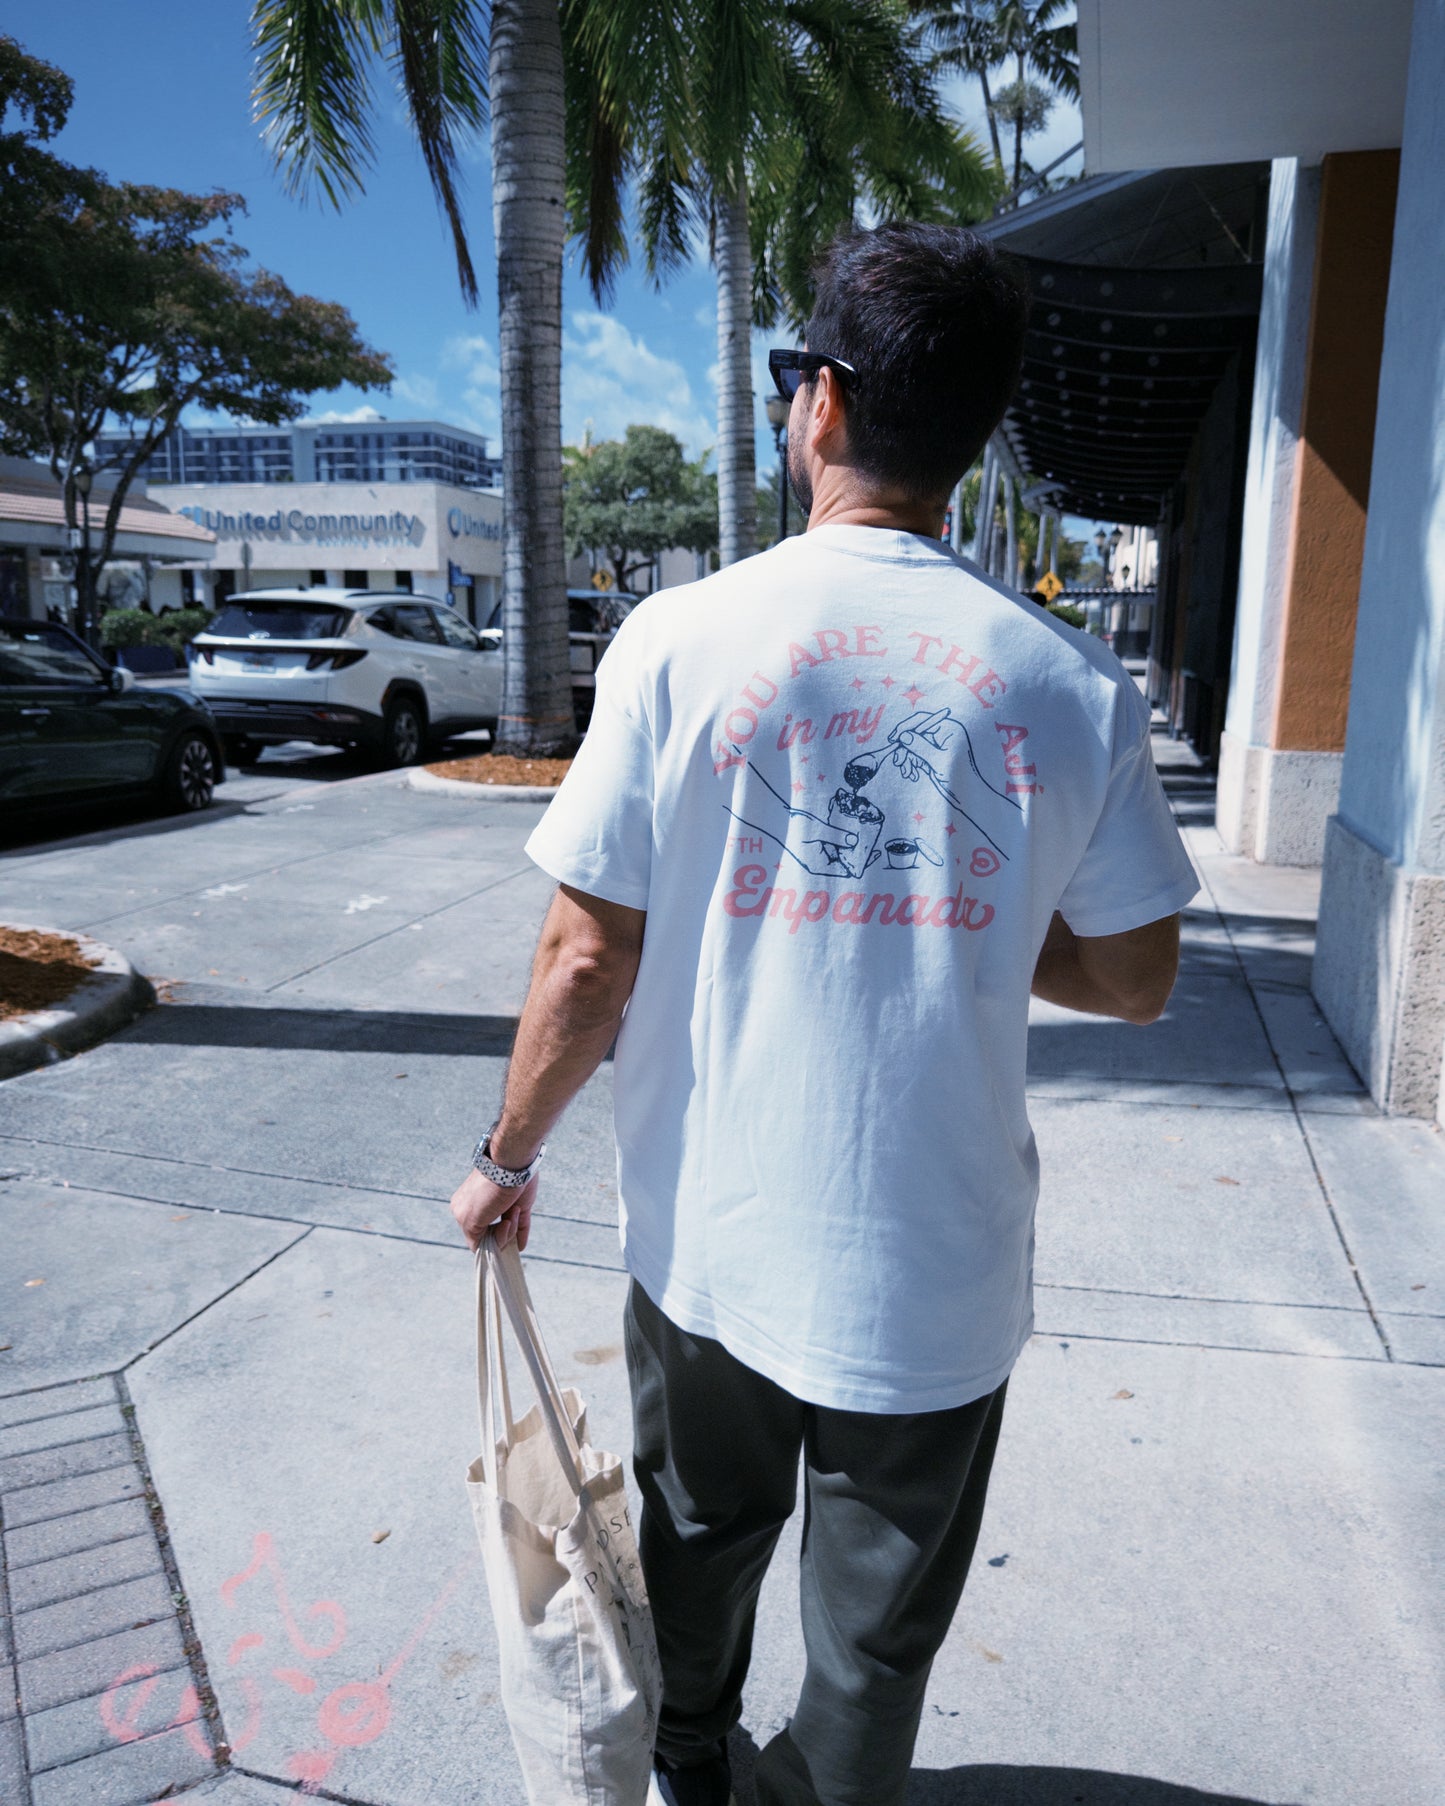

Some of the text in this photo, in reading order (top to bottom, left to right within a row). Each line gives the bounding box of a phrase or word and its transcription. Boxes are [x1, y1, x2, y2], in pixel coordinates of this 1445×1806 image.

[206, 509, 416, 537] United Community
[713, 670, 779, 776] YOU
[788, 625, 888, 678] ARE
[907, 631, 1007, 708] THE
[777, 703, 886, 751] in my
